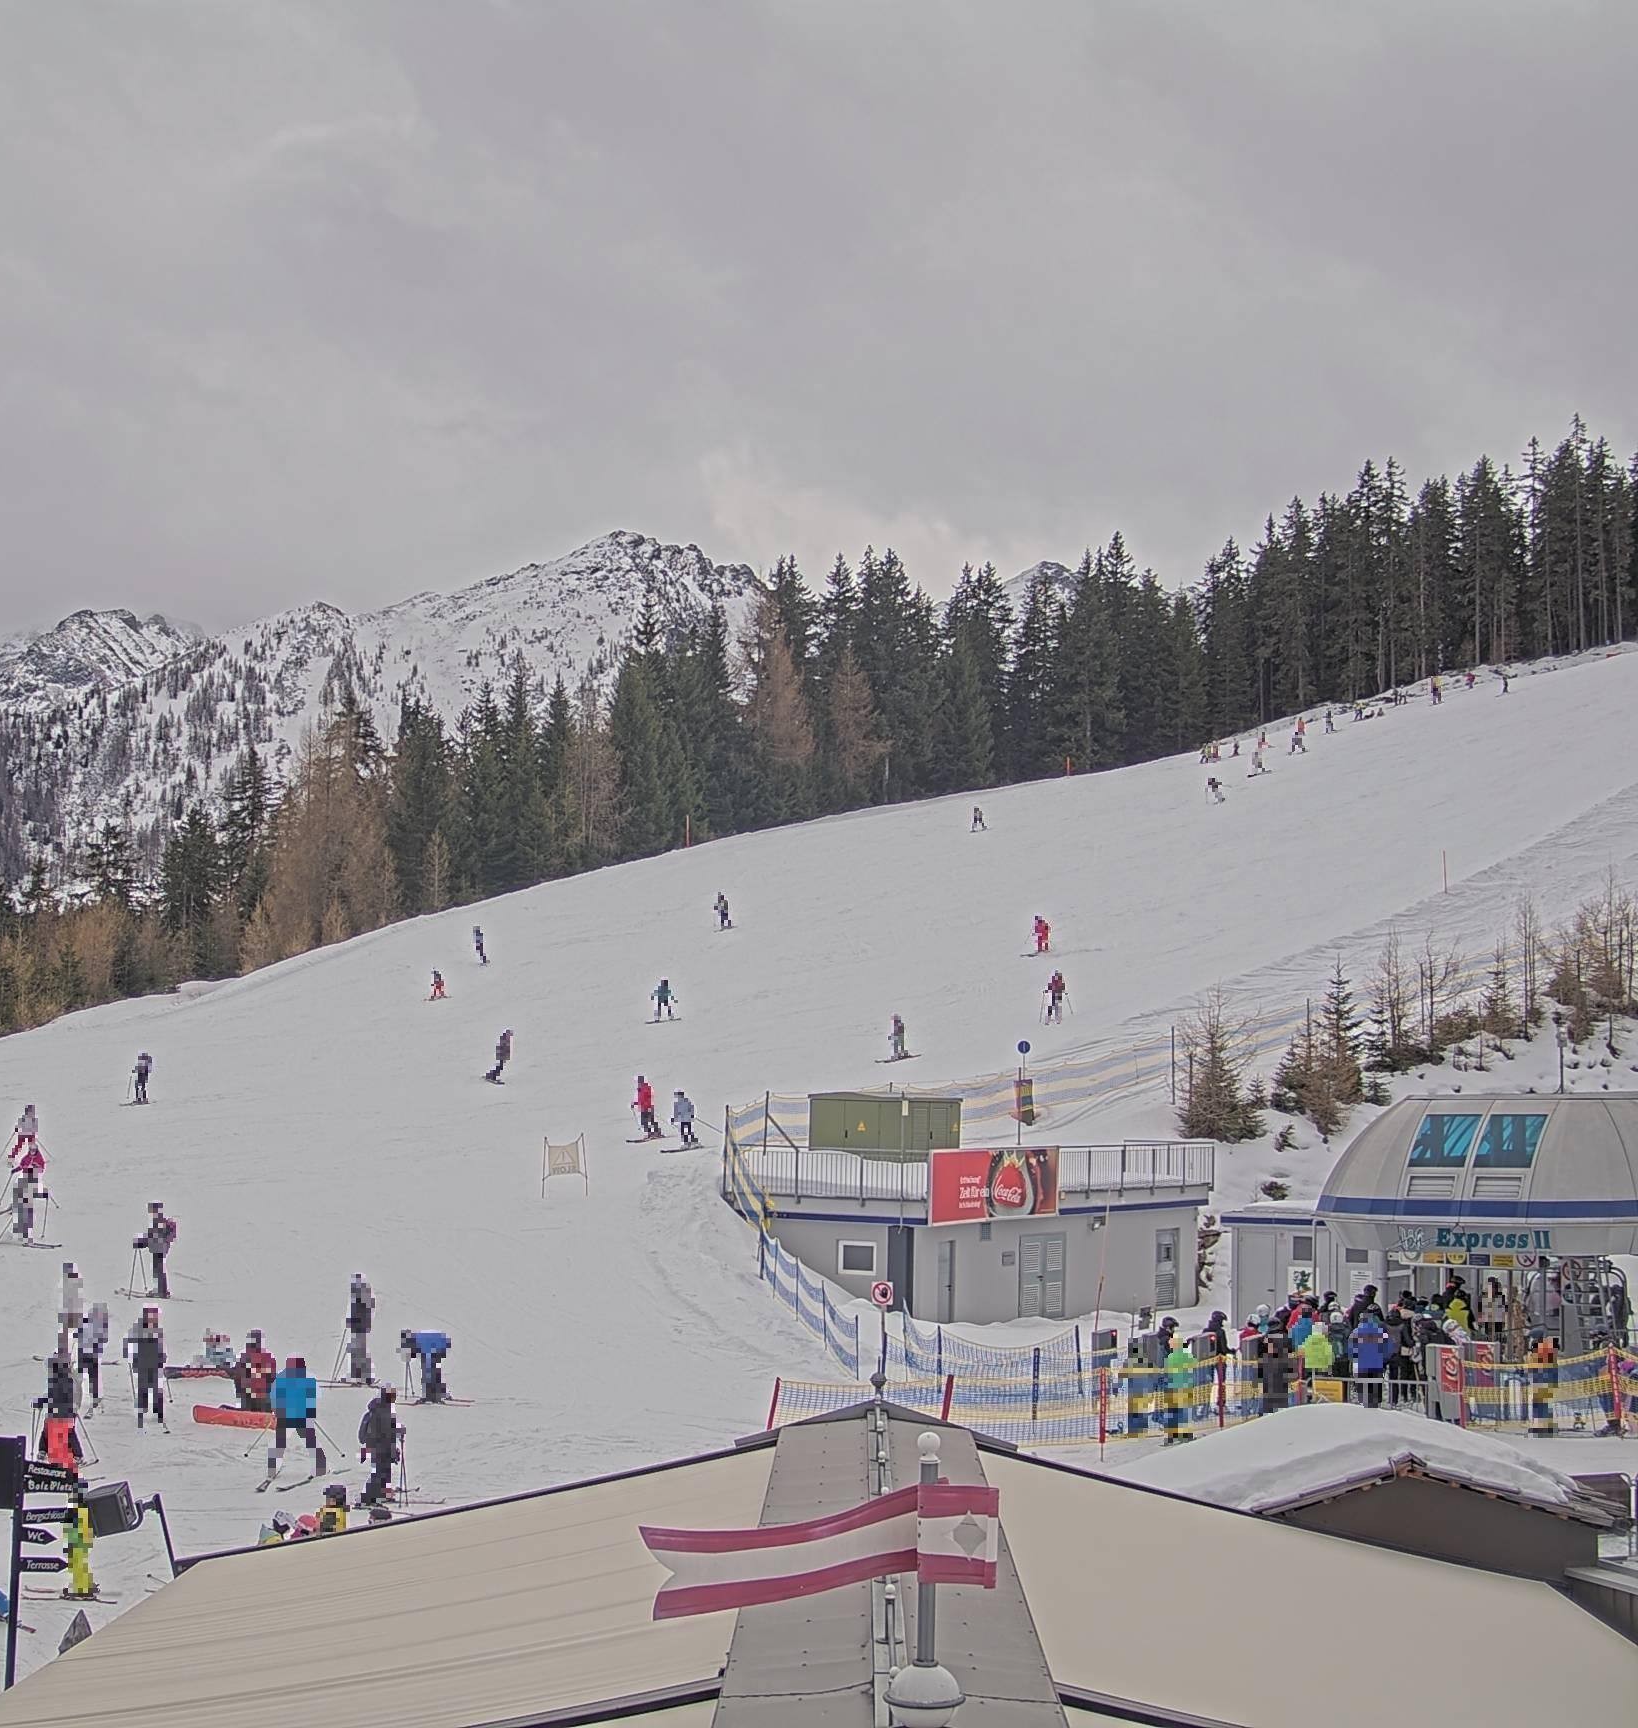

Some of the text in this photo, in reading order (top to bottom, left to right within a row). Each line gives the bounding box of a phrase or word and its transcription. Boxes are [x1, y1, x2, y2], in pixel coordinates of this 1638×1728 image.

[1436, 1227, 1529, 1252] Express
[1532, 1230, 1551, 1249] II
[28, 1530, 46, 1541] WC
[27, 1560, 60, 1571] Terrasse
